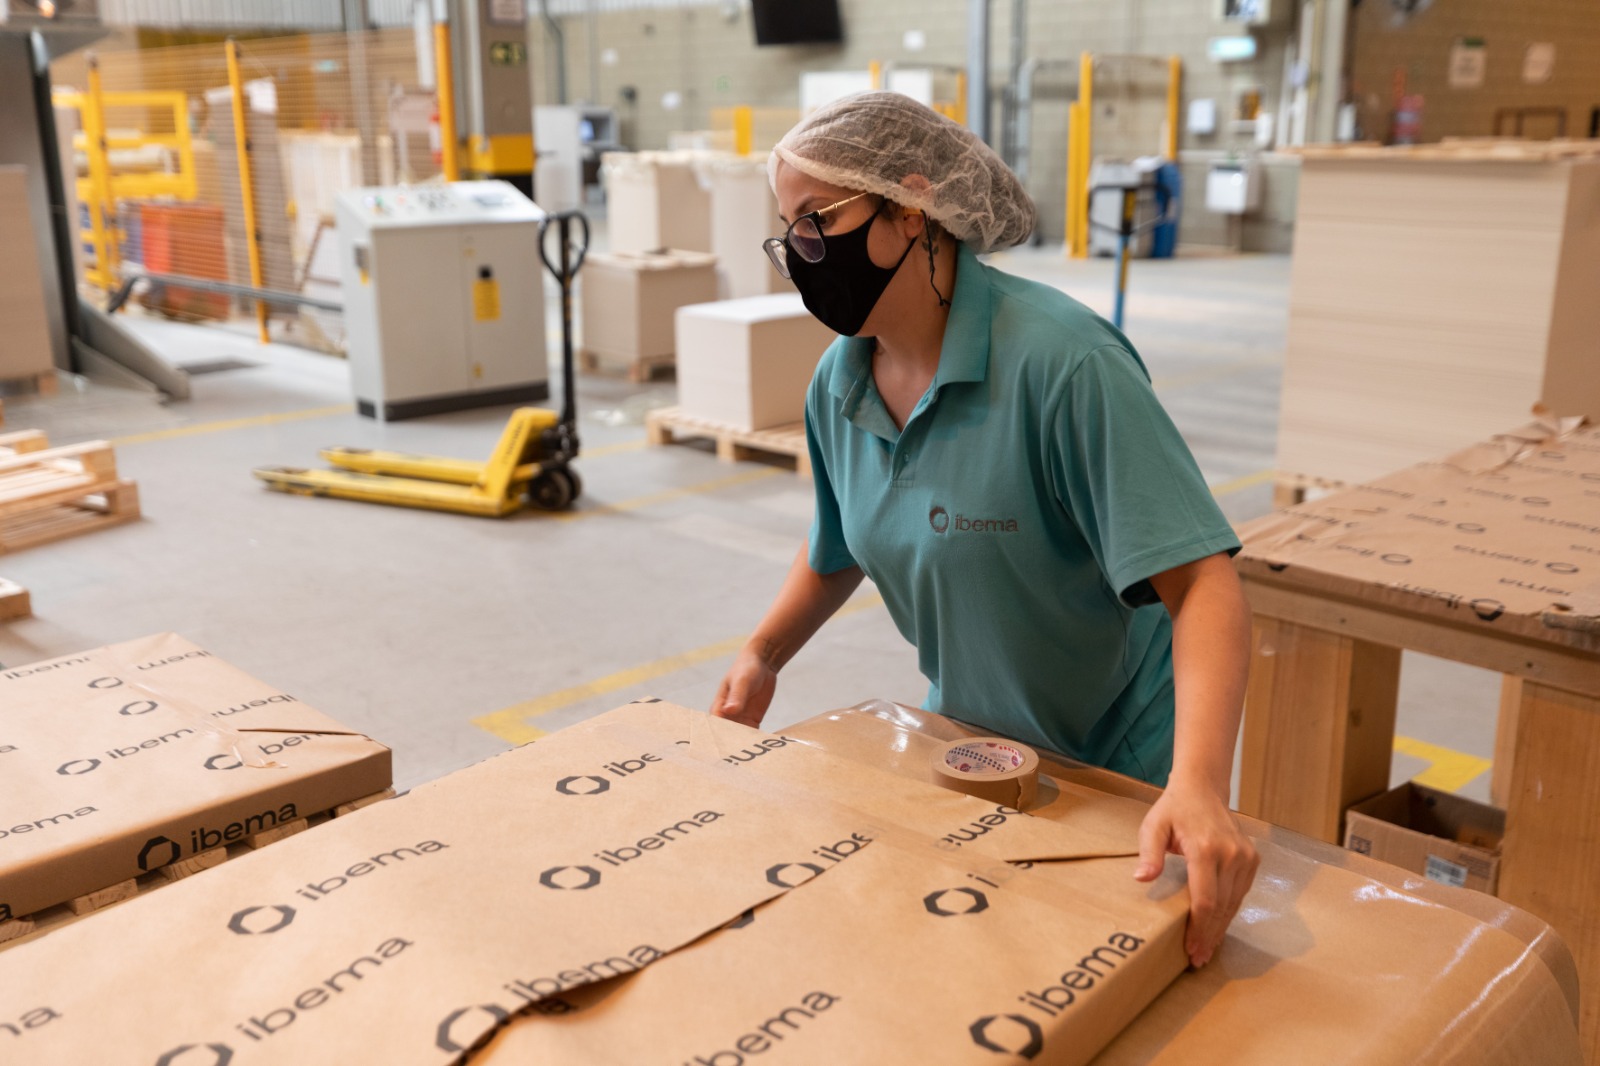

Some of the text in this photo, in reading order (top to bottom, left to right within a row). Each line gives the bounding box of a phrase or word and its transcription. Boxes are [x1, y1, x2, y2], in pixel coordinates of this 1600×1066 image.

[955, 513, 1019, 532] ibema
[3, 656, 91, 680] ibem
[105, 727, 197, 760] ibem
[191, 802, 298, 853] ibema
[593, 810, 725, 868] ibema
[296, 836, 450, 901] ibema
[235, 936, 414, 1042] ibema
[503, 945, 668, 1004] ibema
[1019, 931, 1146, 1018] ibema
[682, 991, 843, 1066] bema
